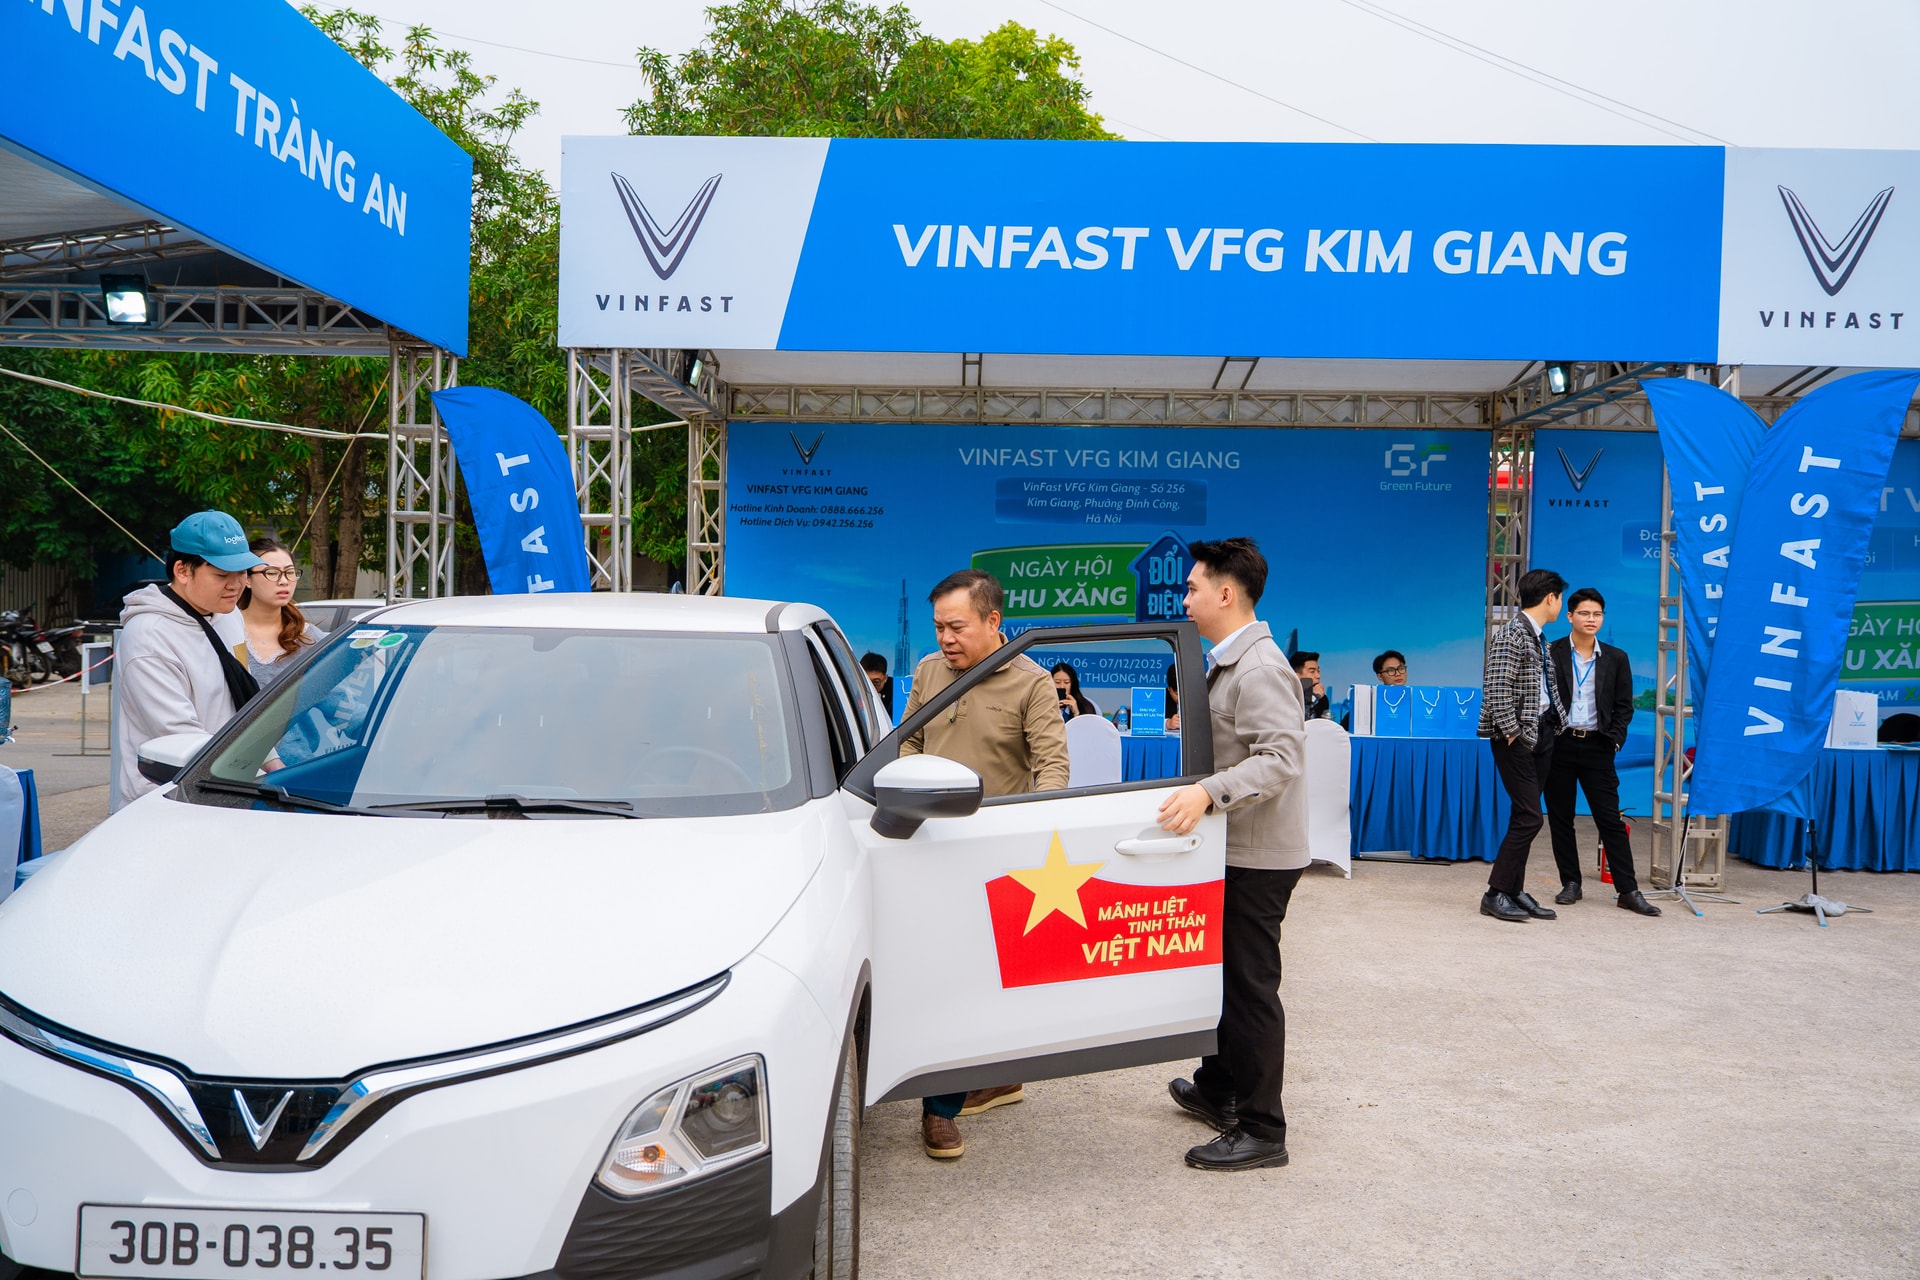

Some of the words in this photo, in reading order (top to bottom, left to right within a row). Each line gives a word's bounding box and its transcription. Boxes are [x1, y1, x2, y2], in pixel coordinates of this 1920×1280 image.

[230, 72, 356, 203] TRÀNG
[362, 172, 407, 237] AN
[893, 224, 1149, 271] VINFAST
[1165, 227, 1284, 272] VFG
[1304, 228, 1413, 274] KIM
[1432, 230, 1628, 276] GIANG
[595, 294, 734, 313] VINFAST
[1759, 310, 1906, 330] VINFAST
[958, 448, 1058, 467] VINFAST
[1064, 449, 1111, 468] VFG
[1118, 450, 1158, 469] KIM
[1166, 451, 1240, 470] GIANG
[782, 468, 832, 476] VINFAST
[747, 484, 789, 495] VINFAST
[792, 485, 812, 495] VFG
[813, 485, 833, 495] KIM
[835, 486, 868, 496] GIANG
[1023, 481, 1062, 492] VinFast
[1065, 482, 1086, 493] VFG
[1088, 482, 1108, 493] Kim
[1111, 483, 1141, 496] Giang
[1150, 481, 1164, 493] Số
[1166, 483, 1185, 494] 256
[1380, 481, 1413, 491] Green
[1415, 481, 1452, 491] Future
[730, 504, 762, 513] Hotline
[764, 504, 784, 513] Kinh
[786, 504, 818, 514] Doanh:
[820, 505, 884, 515] 0888.666.256
[1027, 497, 1048, 508] Kim
[1050, 498, 1082, 510] Giang,
[1085, 498, 1123, 511] Phường
[1125, 498, 1150, 511] Định
[1152, 498, 1181, 511] Công,
[1548, 498, 1609, 508] VINFAST
[495, 452, 555, 593] FAST
[740, 517, 772, 526] Hotline
[774, 517, 794, 529] Dịch
[812, 518, 874, 529] 0942.256.256
[1085, 513, 1101, 524] Hà
[1103, 513, 1122, 526] Nội
[1009, 556, 1070, 578] NGÀY
[1074, 554, 1113, 580] HỘI
[1148, 544, 1183, 585] ĐỔI
[1003, 588, 1047, 609] HU
[1052, 582, 1128, 608] XĂNG
[1743, 446, 1842, 737] VINFAST
[1147, 589, 1184, 620] ĐIỆN
[1038, 656, 1070, 669] NGÀY
[1072, 659, 1088, 668] 06
[1099, 659, 1163, 669] 07/12/2025
[1085, 672, 1136, 683] THƯƠNG
[1139, 673, 1160, 686] MẠI
[1098, 901, 1149, 922] MÃNH
[1153, 896, 1188, 917] LIỆT
[1128, 918, 1162, 934] TINH
[1166, 911, 1207, 931] THẦN
[1081, 934, 1142, 966] VIỆT
[1147, 930, 1205, 957] NAM
[109, 1220, 394, 1271] 30B-038.35
